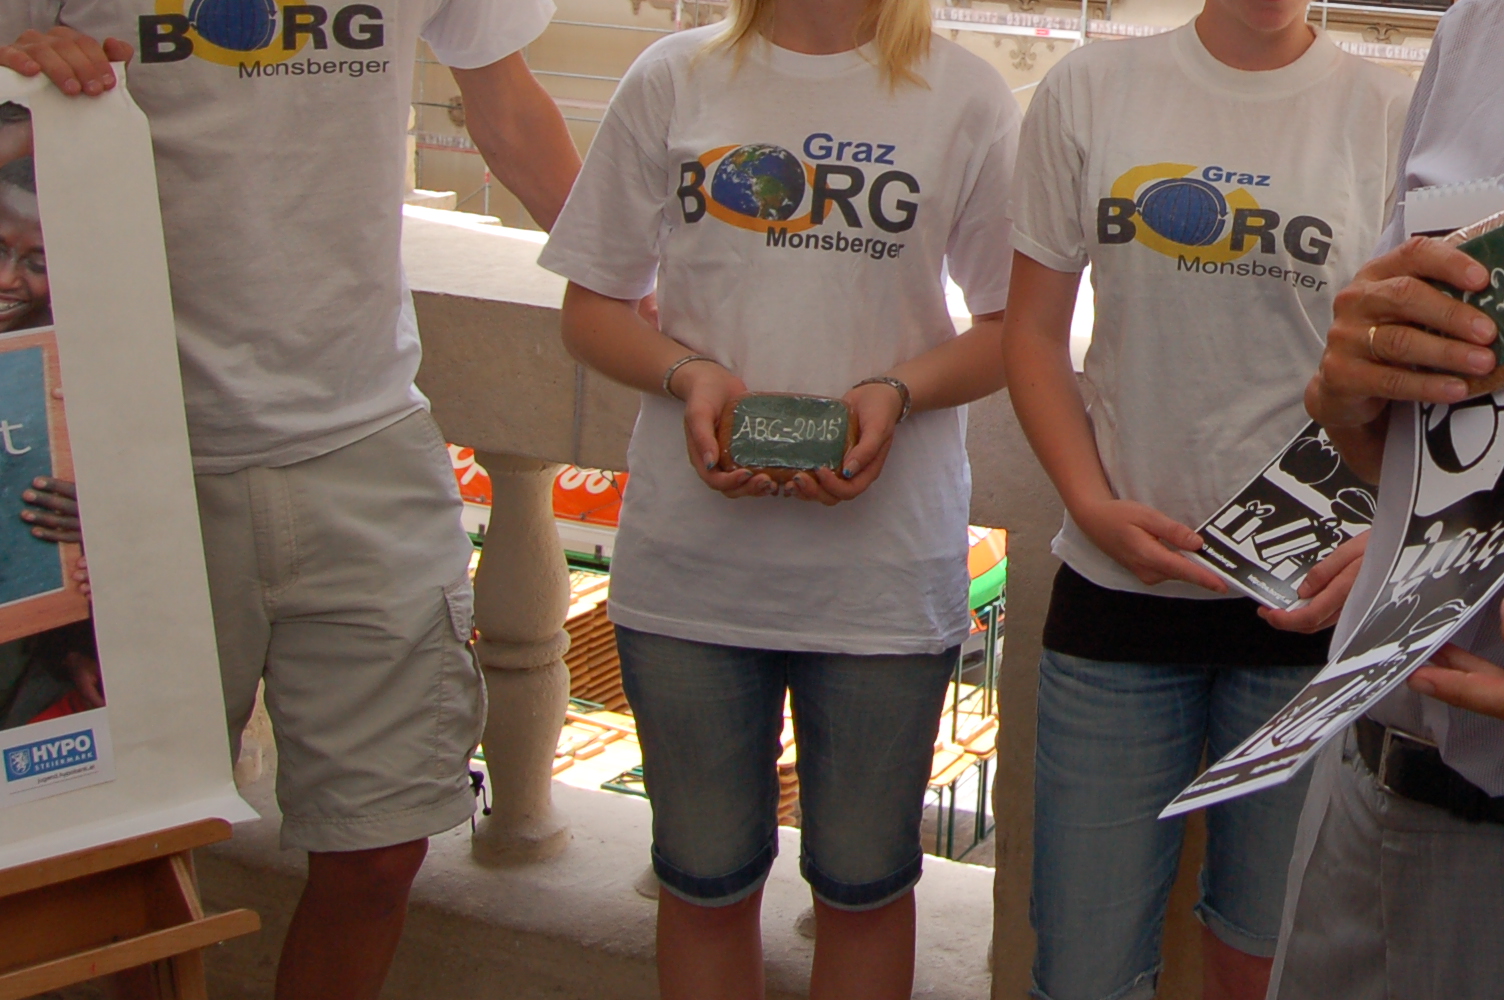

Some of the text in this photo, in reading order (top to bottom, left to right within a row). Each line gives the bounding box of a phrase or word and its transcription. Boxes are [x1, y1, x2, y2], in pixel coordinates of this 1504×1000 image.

[238, 58, 390, 79] Monsberger
[803, 132, 896, 166] Graz
[1202, 166, 1271, 187] Graz
[766, 226, 905, 261] Monsberger
[732, 415, 842, 443] ABC-2015
[32, 734, 91, 764] HYPO
[35, 751, 94, 771] STEIERMARK
